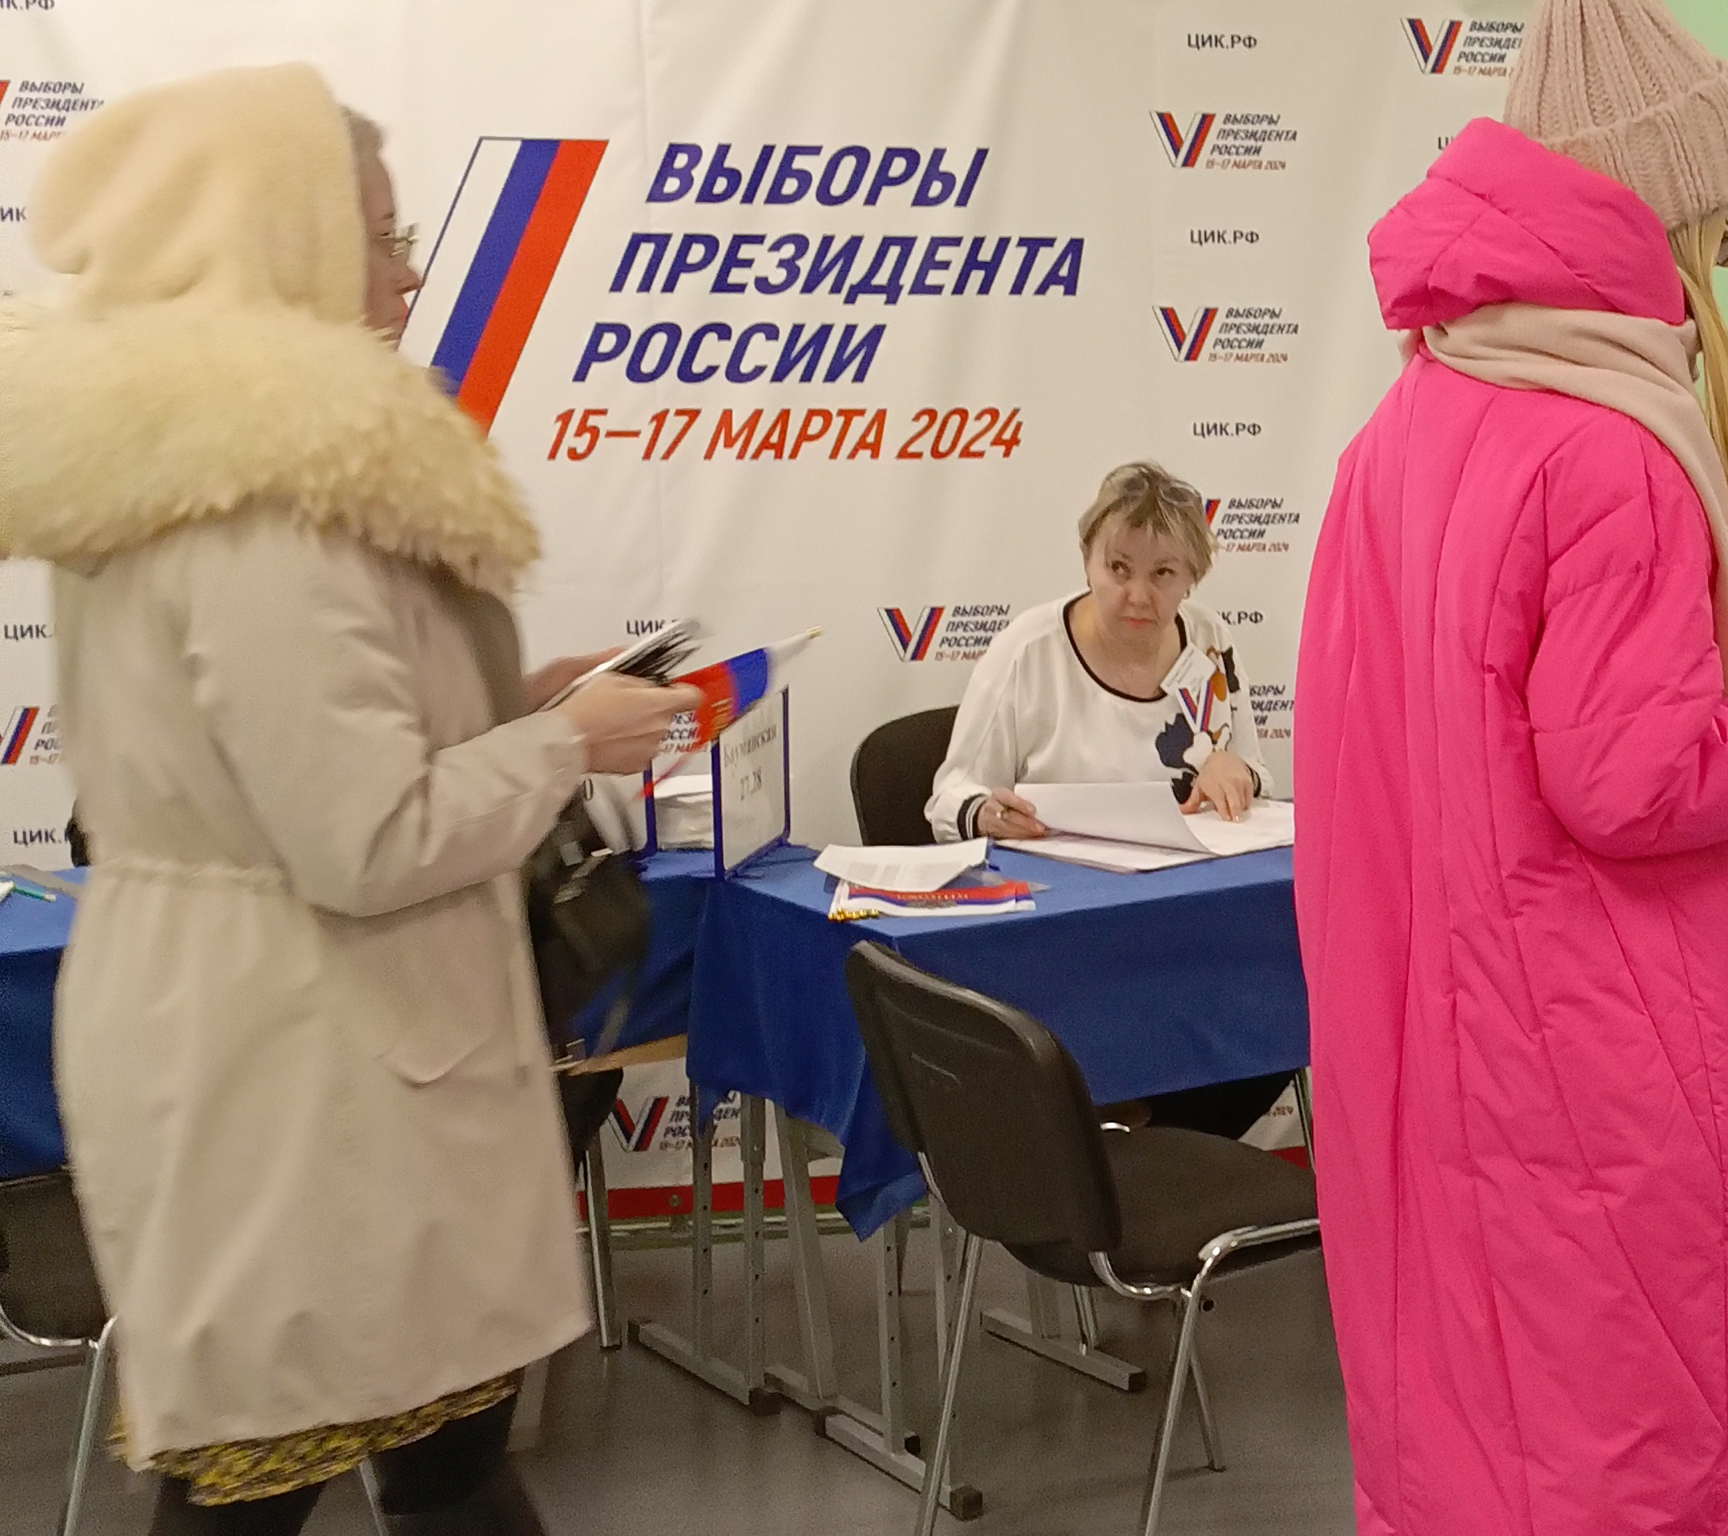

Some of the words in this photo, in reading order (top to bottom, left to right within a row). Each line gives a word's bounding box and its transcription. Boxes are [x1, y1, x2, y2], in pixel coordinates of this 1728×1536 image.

[1469, 20, 1525, 34] ВЫБОРЫ
[1187, 33, 1258, 50] ЦИК.РФ
[1463, 35, 1522, 50] ПРЕЗИДЕ
[1457, 50, 1507, 63] РОССИИ
[18, 80, 85, 94] ВЫБОРЫ
[11, 97, 104, 112] ПРЕЗИДЕНТ
[4, 114, 67, 127] РОССИИ
[1222, 112, 1281, 126] ВЫБОРЫ
[30, 130, 62, 141] МАРТ
[1216, 128, 1298, 142] ПРЕЗИДЕНТА
[1210, 144, 1263, 157] РОССИИ
[645, 142, 990, 207] ВЫБОРЫ
[1190, 229, 1260, 246] ЦИК.РФ
[608, 232, 1085, 305] ПРЕЗИДЕНТА
[1225, 307, 1283, 320] ВЫБОРЫ
[1218, 322, 1299, 336] ПРЕЗИДЕНТА
[1212, 337, 1265, 350] РОССИИ
[571, 321, 887, 384] РОССИИ
[703, 408, 888, 461] МАРТА
[895, 407, 1024, 460] 2024
[1193, 421, 1262, 438] ЦИК.РФ
[1227, 497, 1284, 510] ВЫБОРЫ
[1221, 512, 1300, 526] ПРЕЗИДЕНТА
[1216, 528, 1266, 540] РОССИИ
[952, 604, 1010, 617] ВЫБОРЫ
[1217, 611, 1263, 625] К.РФ
[4, 624, 54, 641] ЦИК.
[946, 619, 1010, 633] ПРЕЗИДЕ
[939, 635, 993, 648] РОССИИ
[1250, 685, 1286, 697] БОРЫ
[13, 828, 69, 846] ЦИК.
